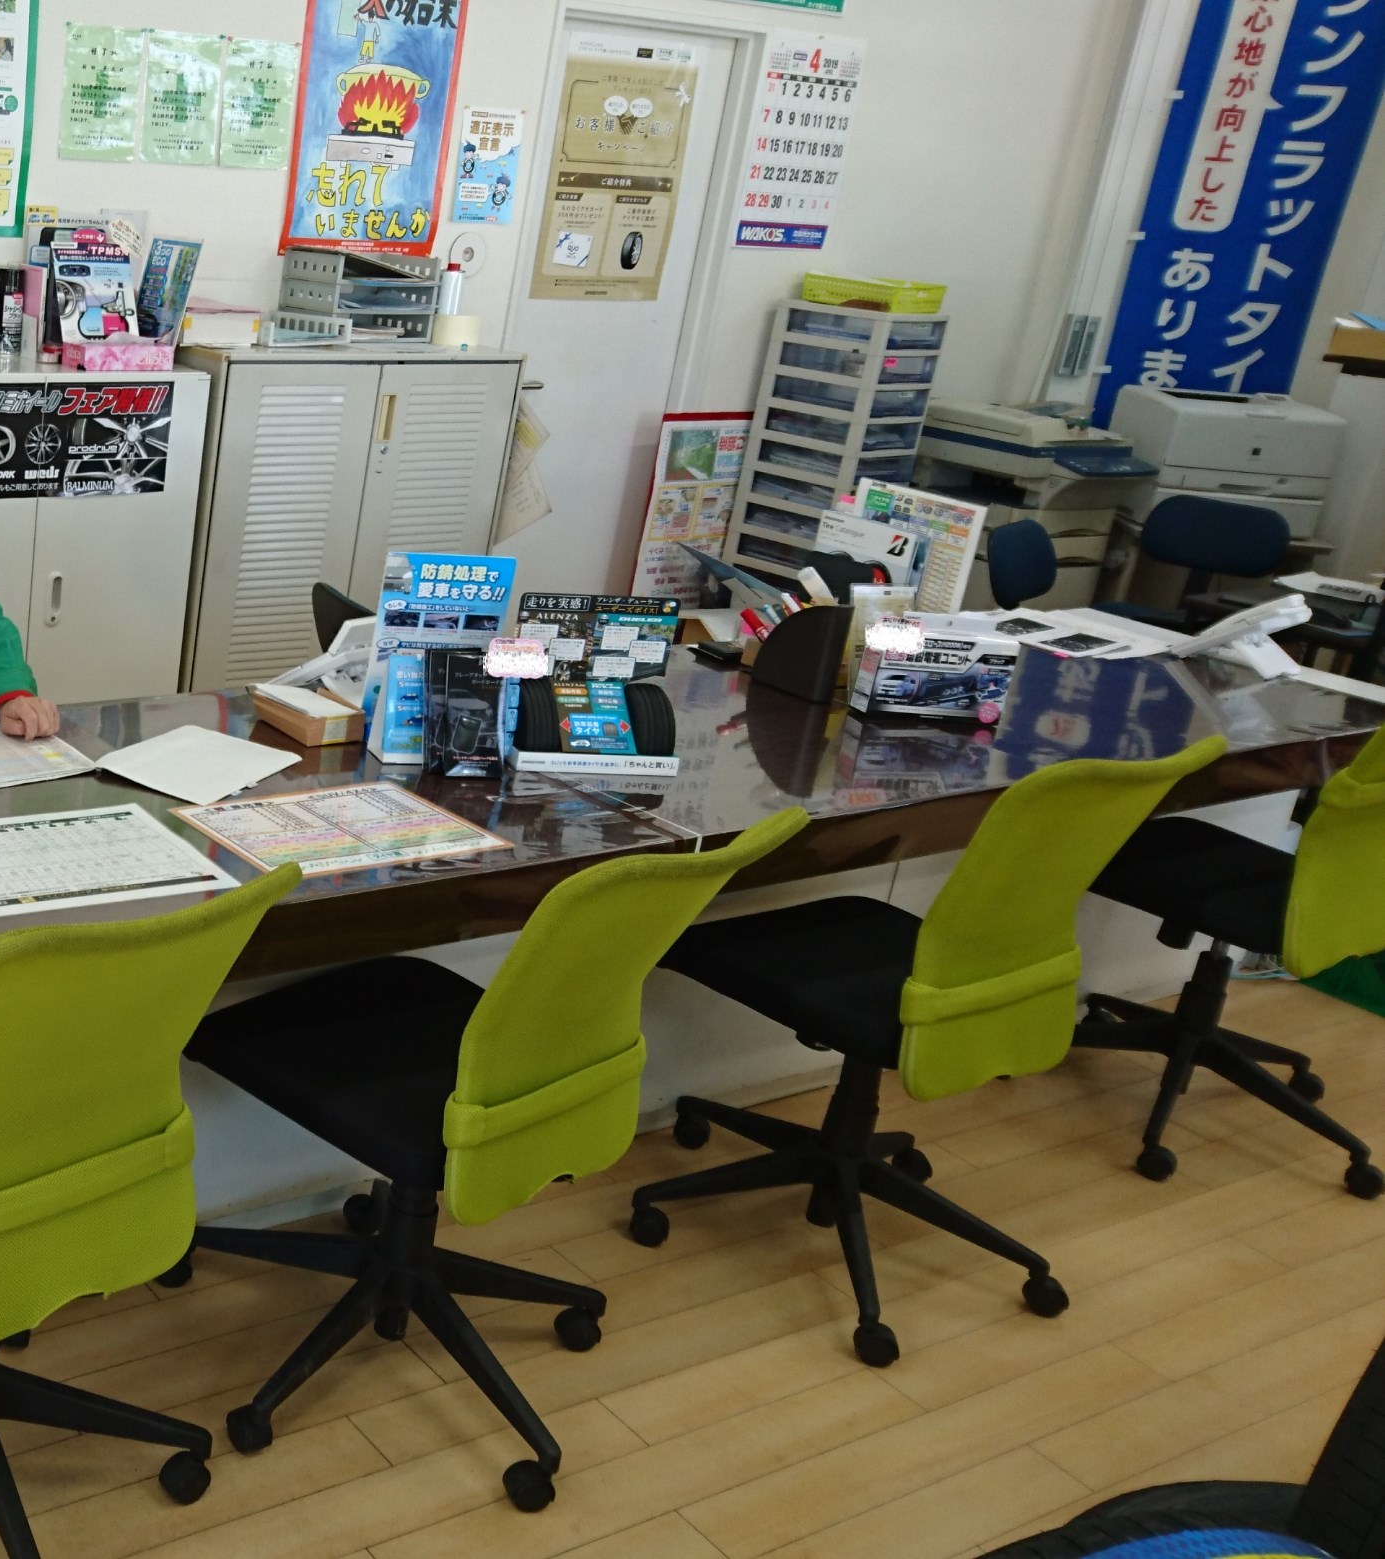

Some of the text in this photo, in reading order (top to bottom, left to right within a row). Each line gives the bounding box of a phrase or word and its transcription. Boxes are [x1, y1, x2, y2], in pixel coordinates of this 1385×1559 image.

[809, 48, 822, 74] 4
[823, 58, 839, 69] 2019
[793, 83, 801, 97] 2
[806, 84, 814, 98] 3
[818, 86, 826, 100] 4
[831, 88, 839, 101] 5
[844, 89, 852, 103] 6
[763, 108, 849, 131] 7 8 9 10 11 12 13
[1189, 0, 1276, 222] 心地が向上した
[470, 120, 514, 137] 適正表示
[575, 117, 615, 134] お客様
[478, 137, 501, 151] 宣言
[597, 142, 646, 153] キャンペーン
[757, 137, 843, 158] 14 15 16 17 18 19 20
[750, 165, 838, 185] 21 22 23 24 25 26 27
[306, 162, 390, 208] 忘れて
[745, 193, 757, 207] 28
[758, 193, 770, 208] 29
[771, 195, 782, 209] 30
[315, 207, 431, 240] いませんか
[1140, 248, 1214, 389] ありま
[68, 444, 118, 454] prodrive
[24, 466, 60, 480] weds
[66, 480, 114, 491] BALMINUM
[822, 522, 835, 530] Tire
[421, 563, 499, 583] 防錆処理で
[417, 582, 506, 601] 愛車を守る!!
[526, 597, 588, 610] 走りを実感!
[536, 613, 579, 621] ALENZA
[576, 727, 600, 735] タイヤ
